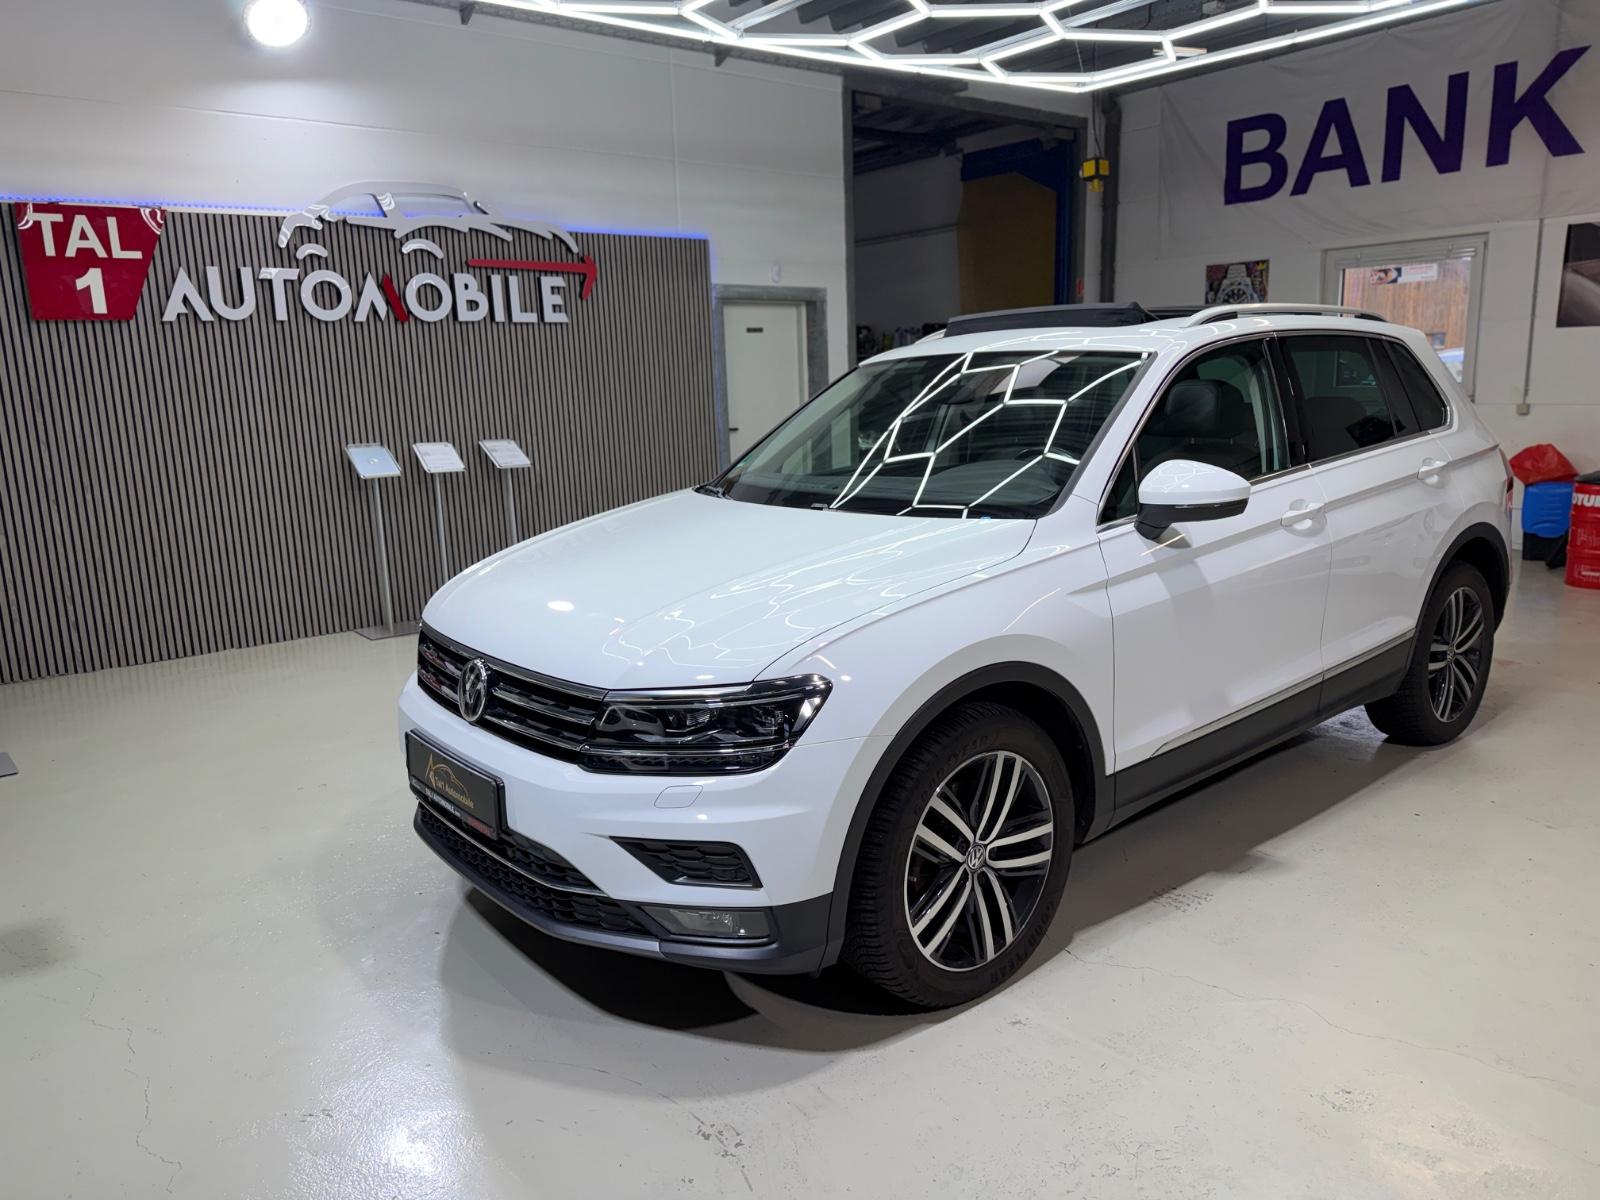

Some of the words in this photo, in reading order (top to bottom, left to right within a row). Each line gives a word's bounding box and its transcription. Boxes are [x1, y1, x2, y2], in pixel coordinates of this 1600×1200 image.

[1224, 45, 1592, 206] BANK
[27, 211, 143, 260] TAL
[75, 267, 108, 315] 1
[162, 265, 569, 323] AUTOMOBILE
